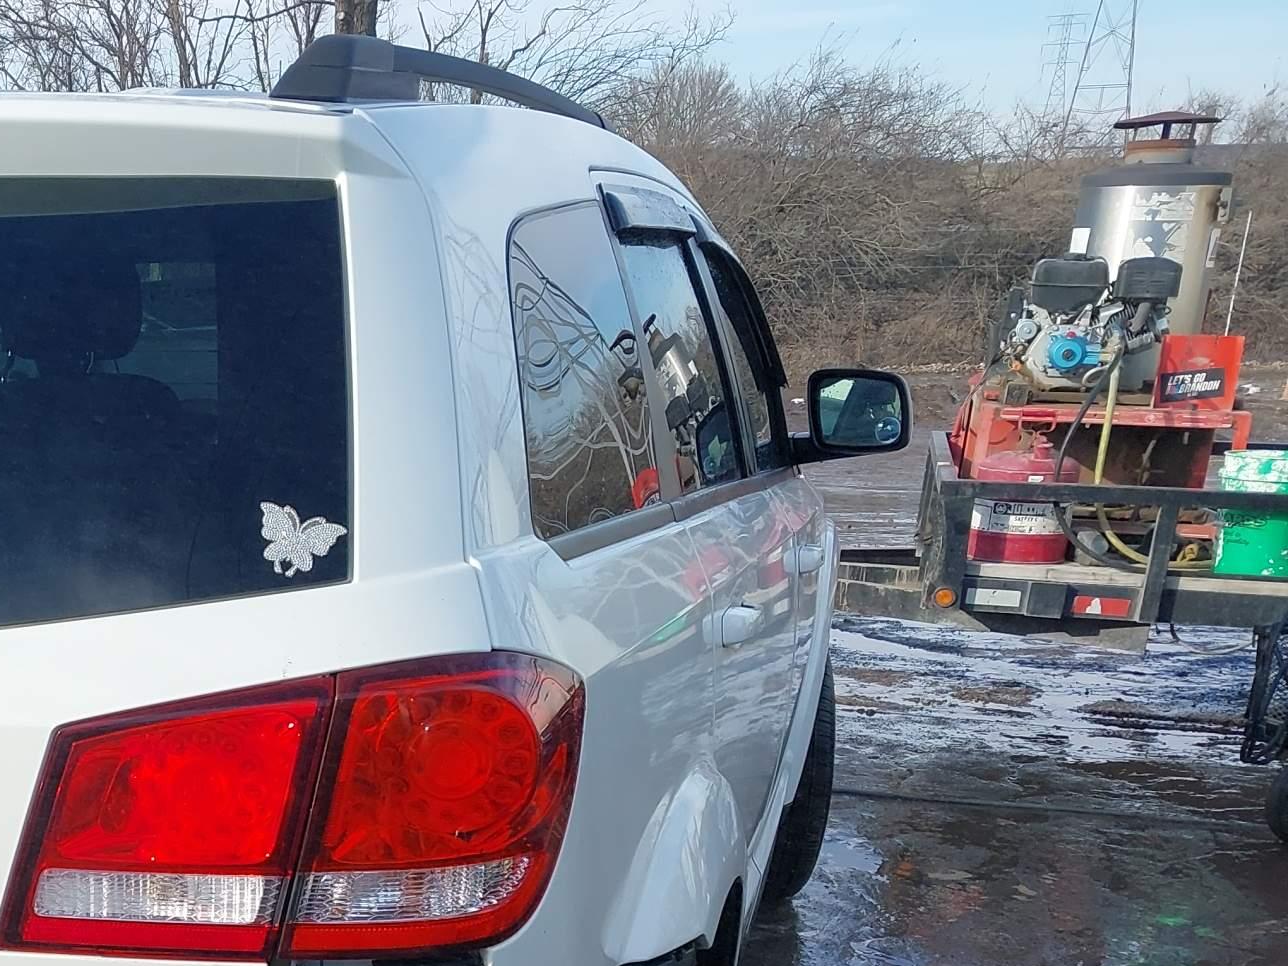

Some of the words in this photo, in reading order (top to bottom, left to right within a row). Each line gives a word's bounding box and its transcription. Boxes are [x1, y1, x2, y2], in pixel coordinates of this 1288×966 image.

[1167, 374, 1192, 386] LET'S
[1193, 372, 1207, 383] GO
[1179, 380, 1221, 394] BRANDON
